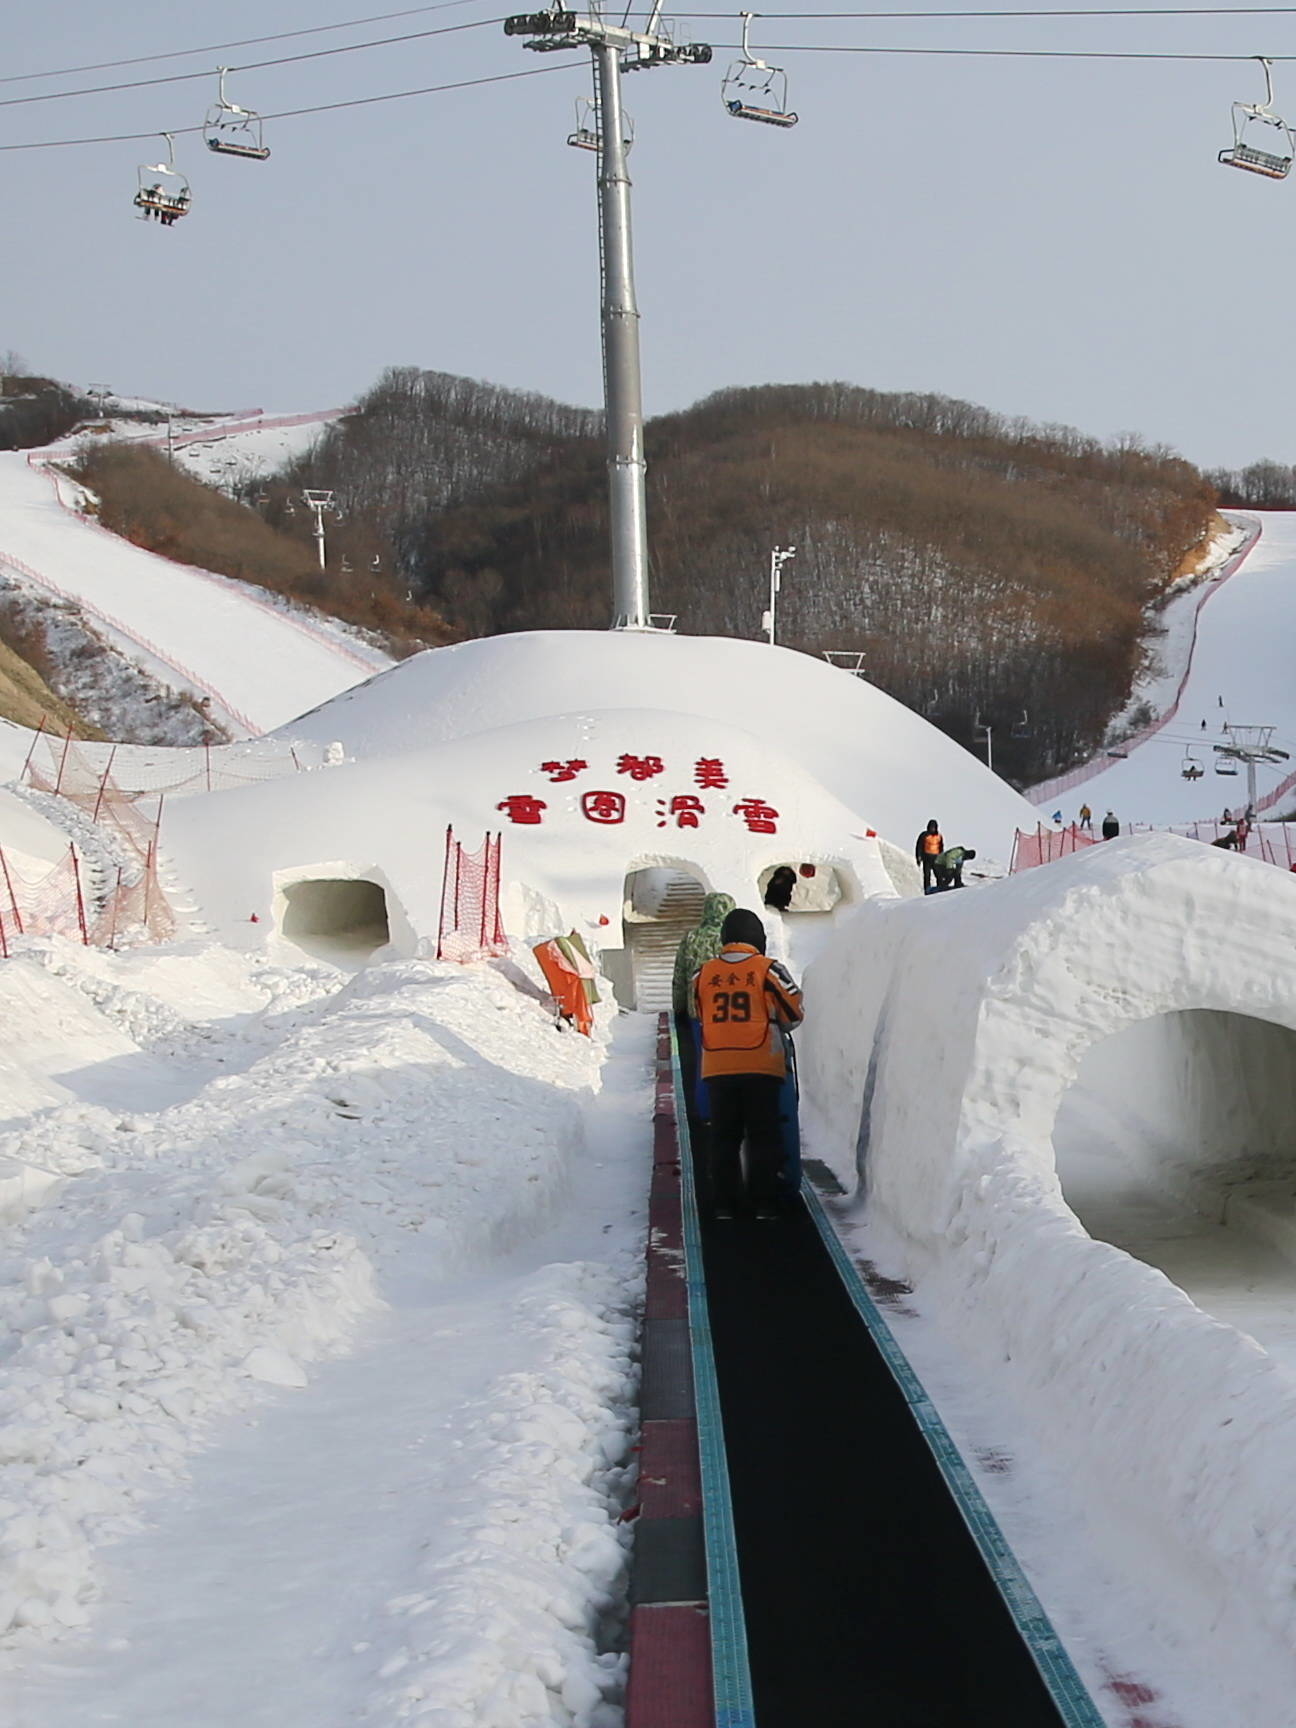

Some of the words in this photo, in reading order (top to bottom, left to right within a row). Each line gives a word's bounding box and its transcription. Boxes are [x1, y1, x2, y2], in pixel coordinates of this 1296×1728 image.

[541, 754, 730, 790] 梦都美
[712, 991, 752, 1023] 39
